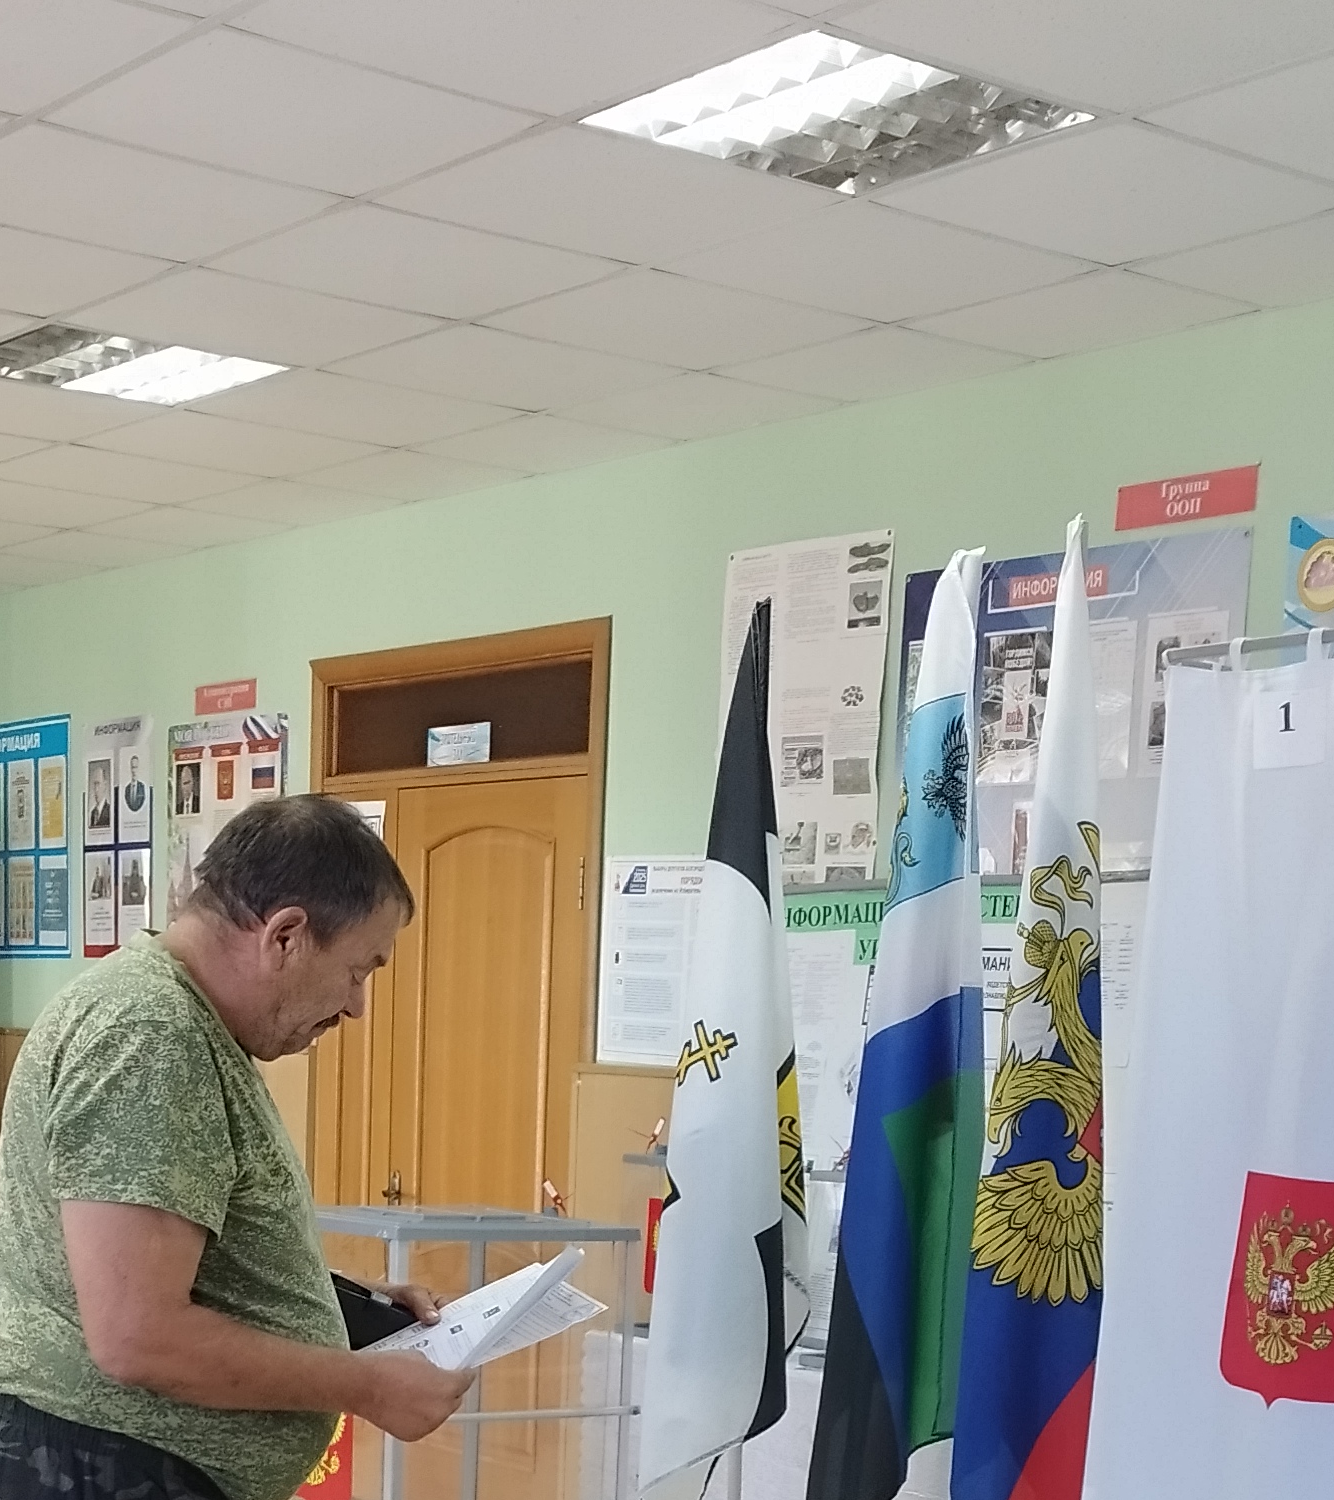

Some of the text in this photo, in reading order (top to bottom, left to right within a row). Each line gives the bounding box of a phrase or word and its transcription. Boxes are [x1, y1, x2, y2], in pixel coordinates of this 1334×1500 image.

[1161, 479, 1210, 500] Группа
[1166, 497, 1202, 518] ООП
[1012, 569, 1103, 600] ИНФОРИЯ
[1279, 701, 1296, 732] 1
[94, 720, 142, 737] ИНФОРМАЦИЯ
